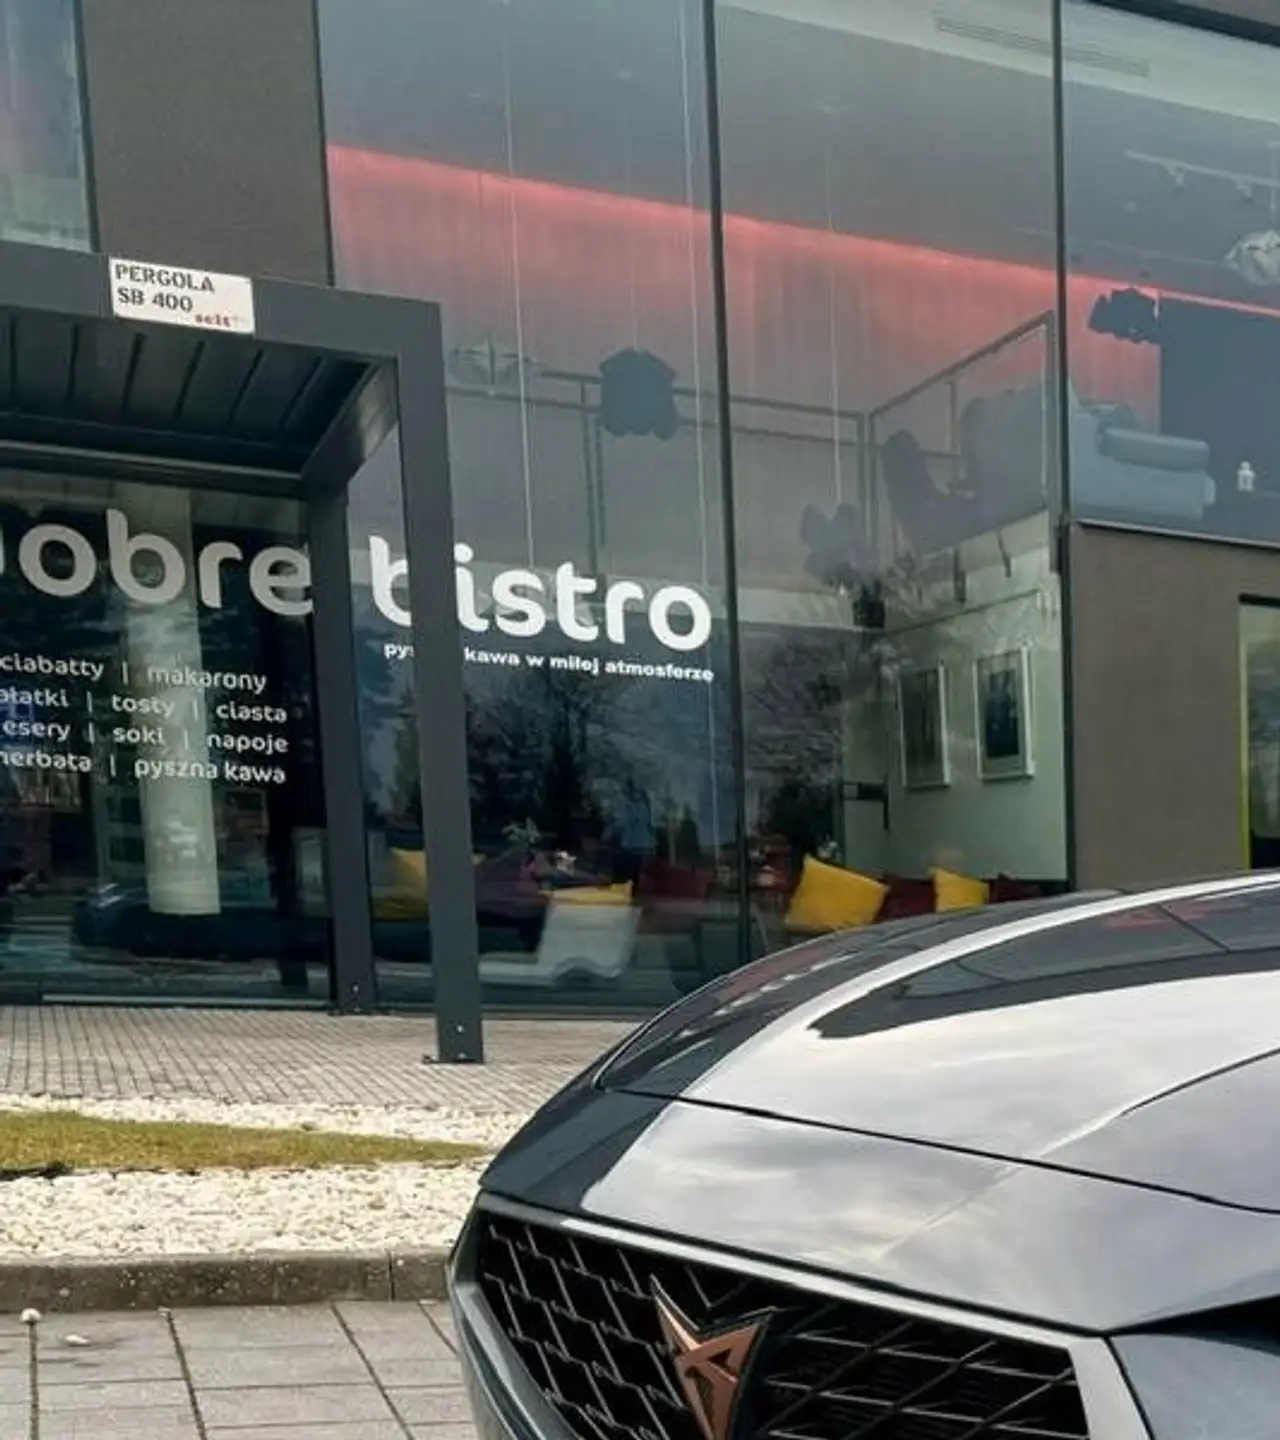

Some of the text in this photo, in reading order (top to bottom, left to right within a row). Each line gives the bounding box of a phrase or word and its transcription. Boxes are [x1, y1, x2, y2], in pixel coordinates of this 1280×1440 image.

[115, 263, 215, 294] PERGOLA
[117, 287, 194, 313] SB 400
[0, 508, 712, 651] obre bistro
[0, 653, 268, 695] ciabatty makarony
[463, 646, 520, 667] kawa
[525, 652, 544, 667] w
[549, 654, 600, 676] miłej
[604, 659, 714, 684] atmosferze
[112, 693, 175, 718] tosty
[215, 700, 288, 724] ciasta
[2, 719, 290, 756] esery soki napoje
[134, 757, 218, 781] pyszna
[224, 761, 287, 784] kawa
